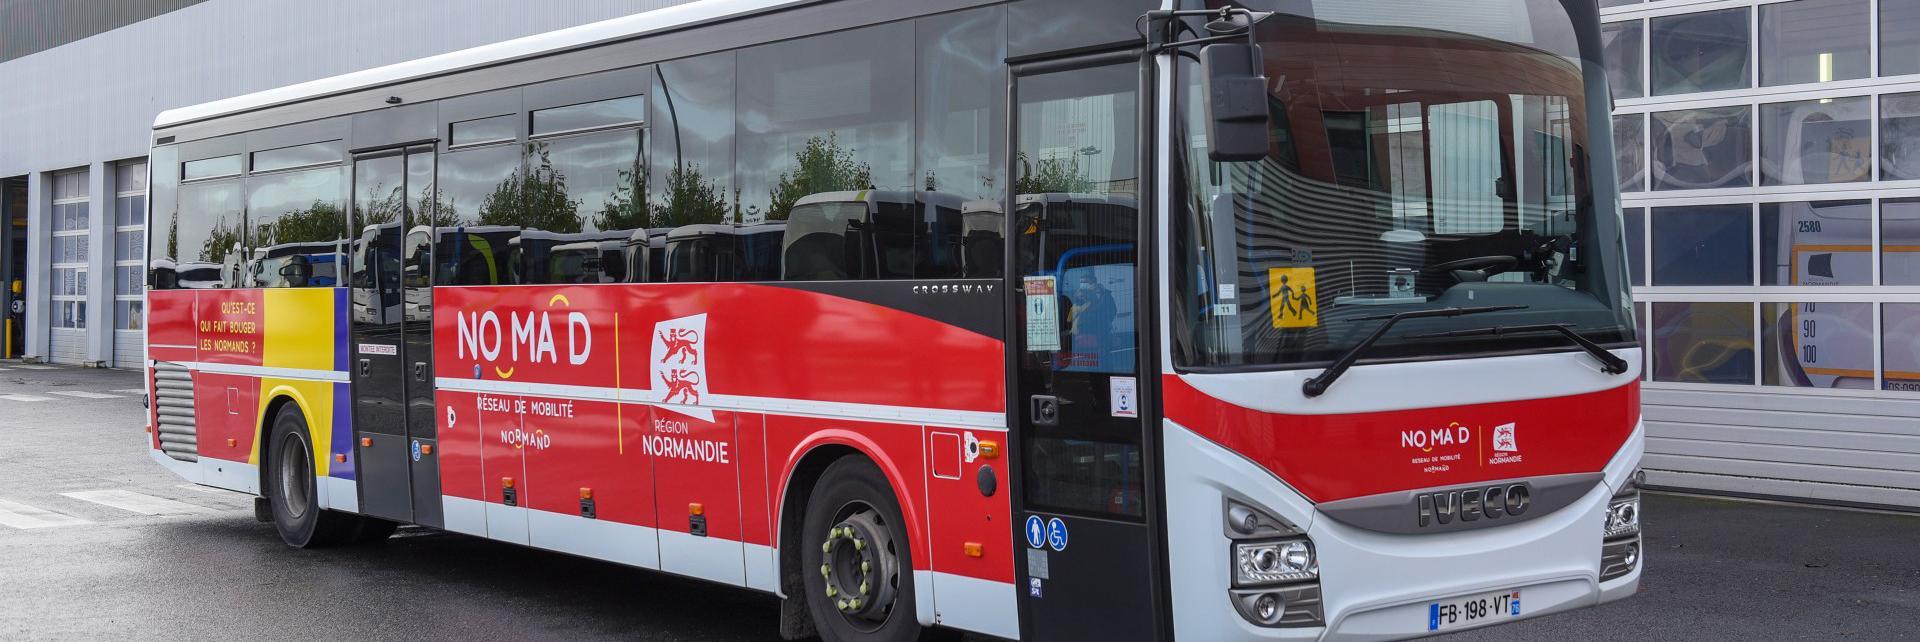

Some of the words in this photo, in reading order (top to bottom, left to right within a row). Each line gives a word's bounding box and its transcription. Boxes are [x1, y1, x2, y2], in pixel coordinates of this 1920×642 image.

[1798, 221, 1821, 233] 2580
[912, 284, 993, 294] CROSSWAY
[221, 302, 256, 315] QU'EST-CE
[200, 320, 211, 332] QUI
[213, 321, 227, 333] FAIT
[230, 321, 256, 333] BOUGER
[1803, 320, 1816, 338] 90
[200, 339, 211, 351] LES
[214, 340, 249, 353] NORMANDS
[1803, 345, 1817, 363] 100
[477, 394, 510, 412] RÉSEAU
[514, 400, 527, 414] DE
[531, 400, 574, 418] MOBILITÉ
[654, 418, 689, 434] RÉGION
[500, 428, 550, 450] NORMAND
[642, 435, 730, 464] NORMANDIE
[1489, 455, 1522, 464] NORMANDIE
[1418, 484, 1530, 527] IVECO
